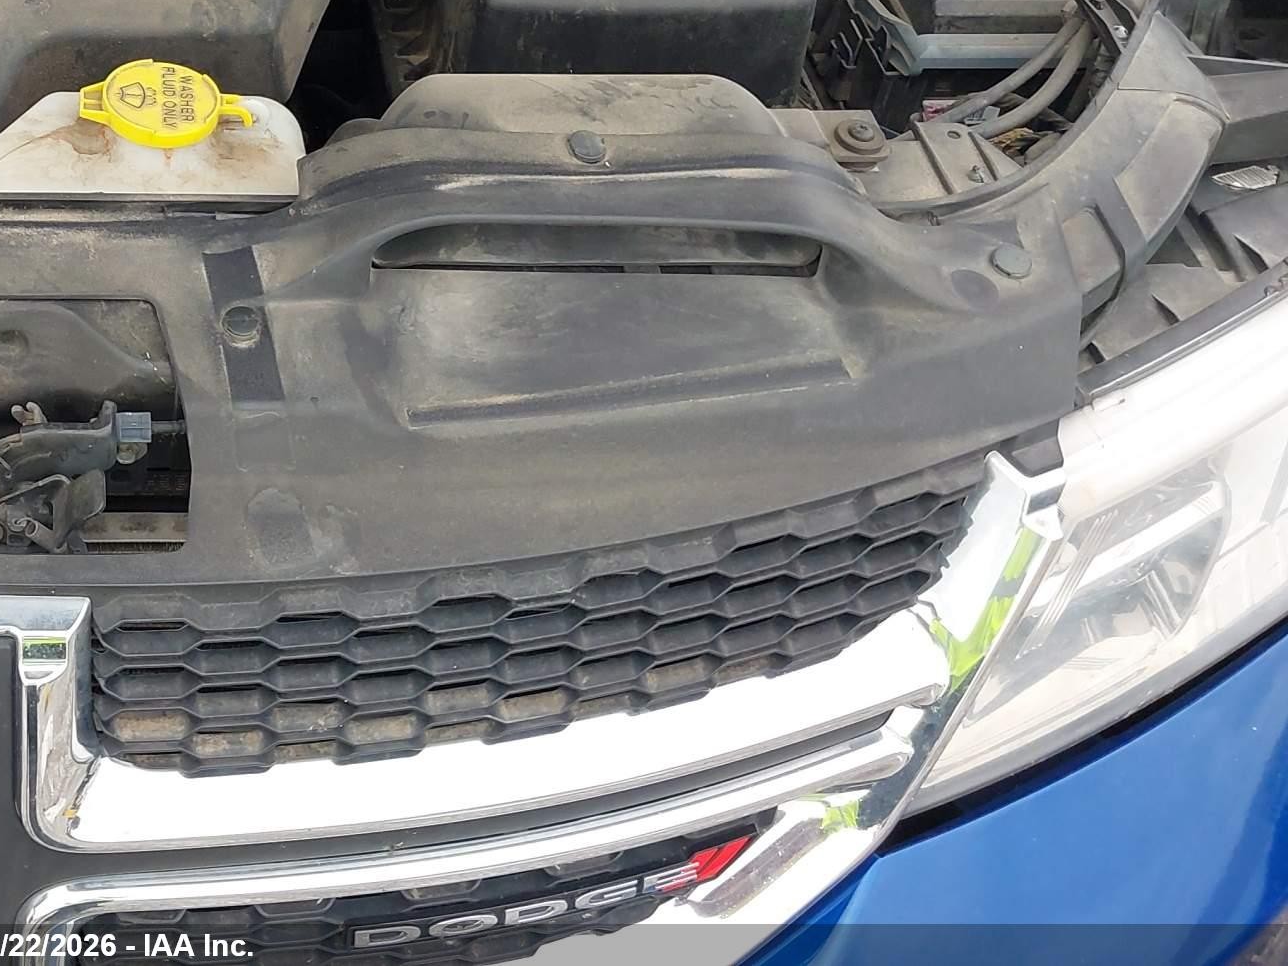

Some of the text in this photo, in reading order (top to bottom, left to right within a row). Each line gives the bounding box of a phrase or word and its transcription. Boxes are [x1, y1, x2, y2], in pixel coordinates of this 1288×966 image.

[162, 66, 177, 129] FLUID ONLY
[180, 75, 195, 122] WASHER
[354, 860, 700, 949] DODGE
